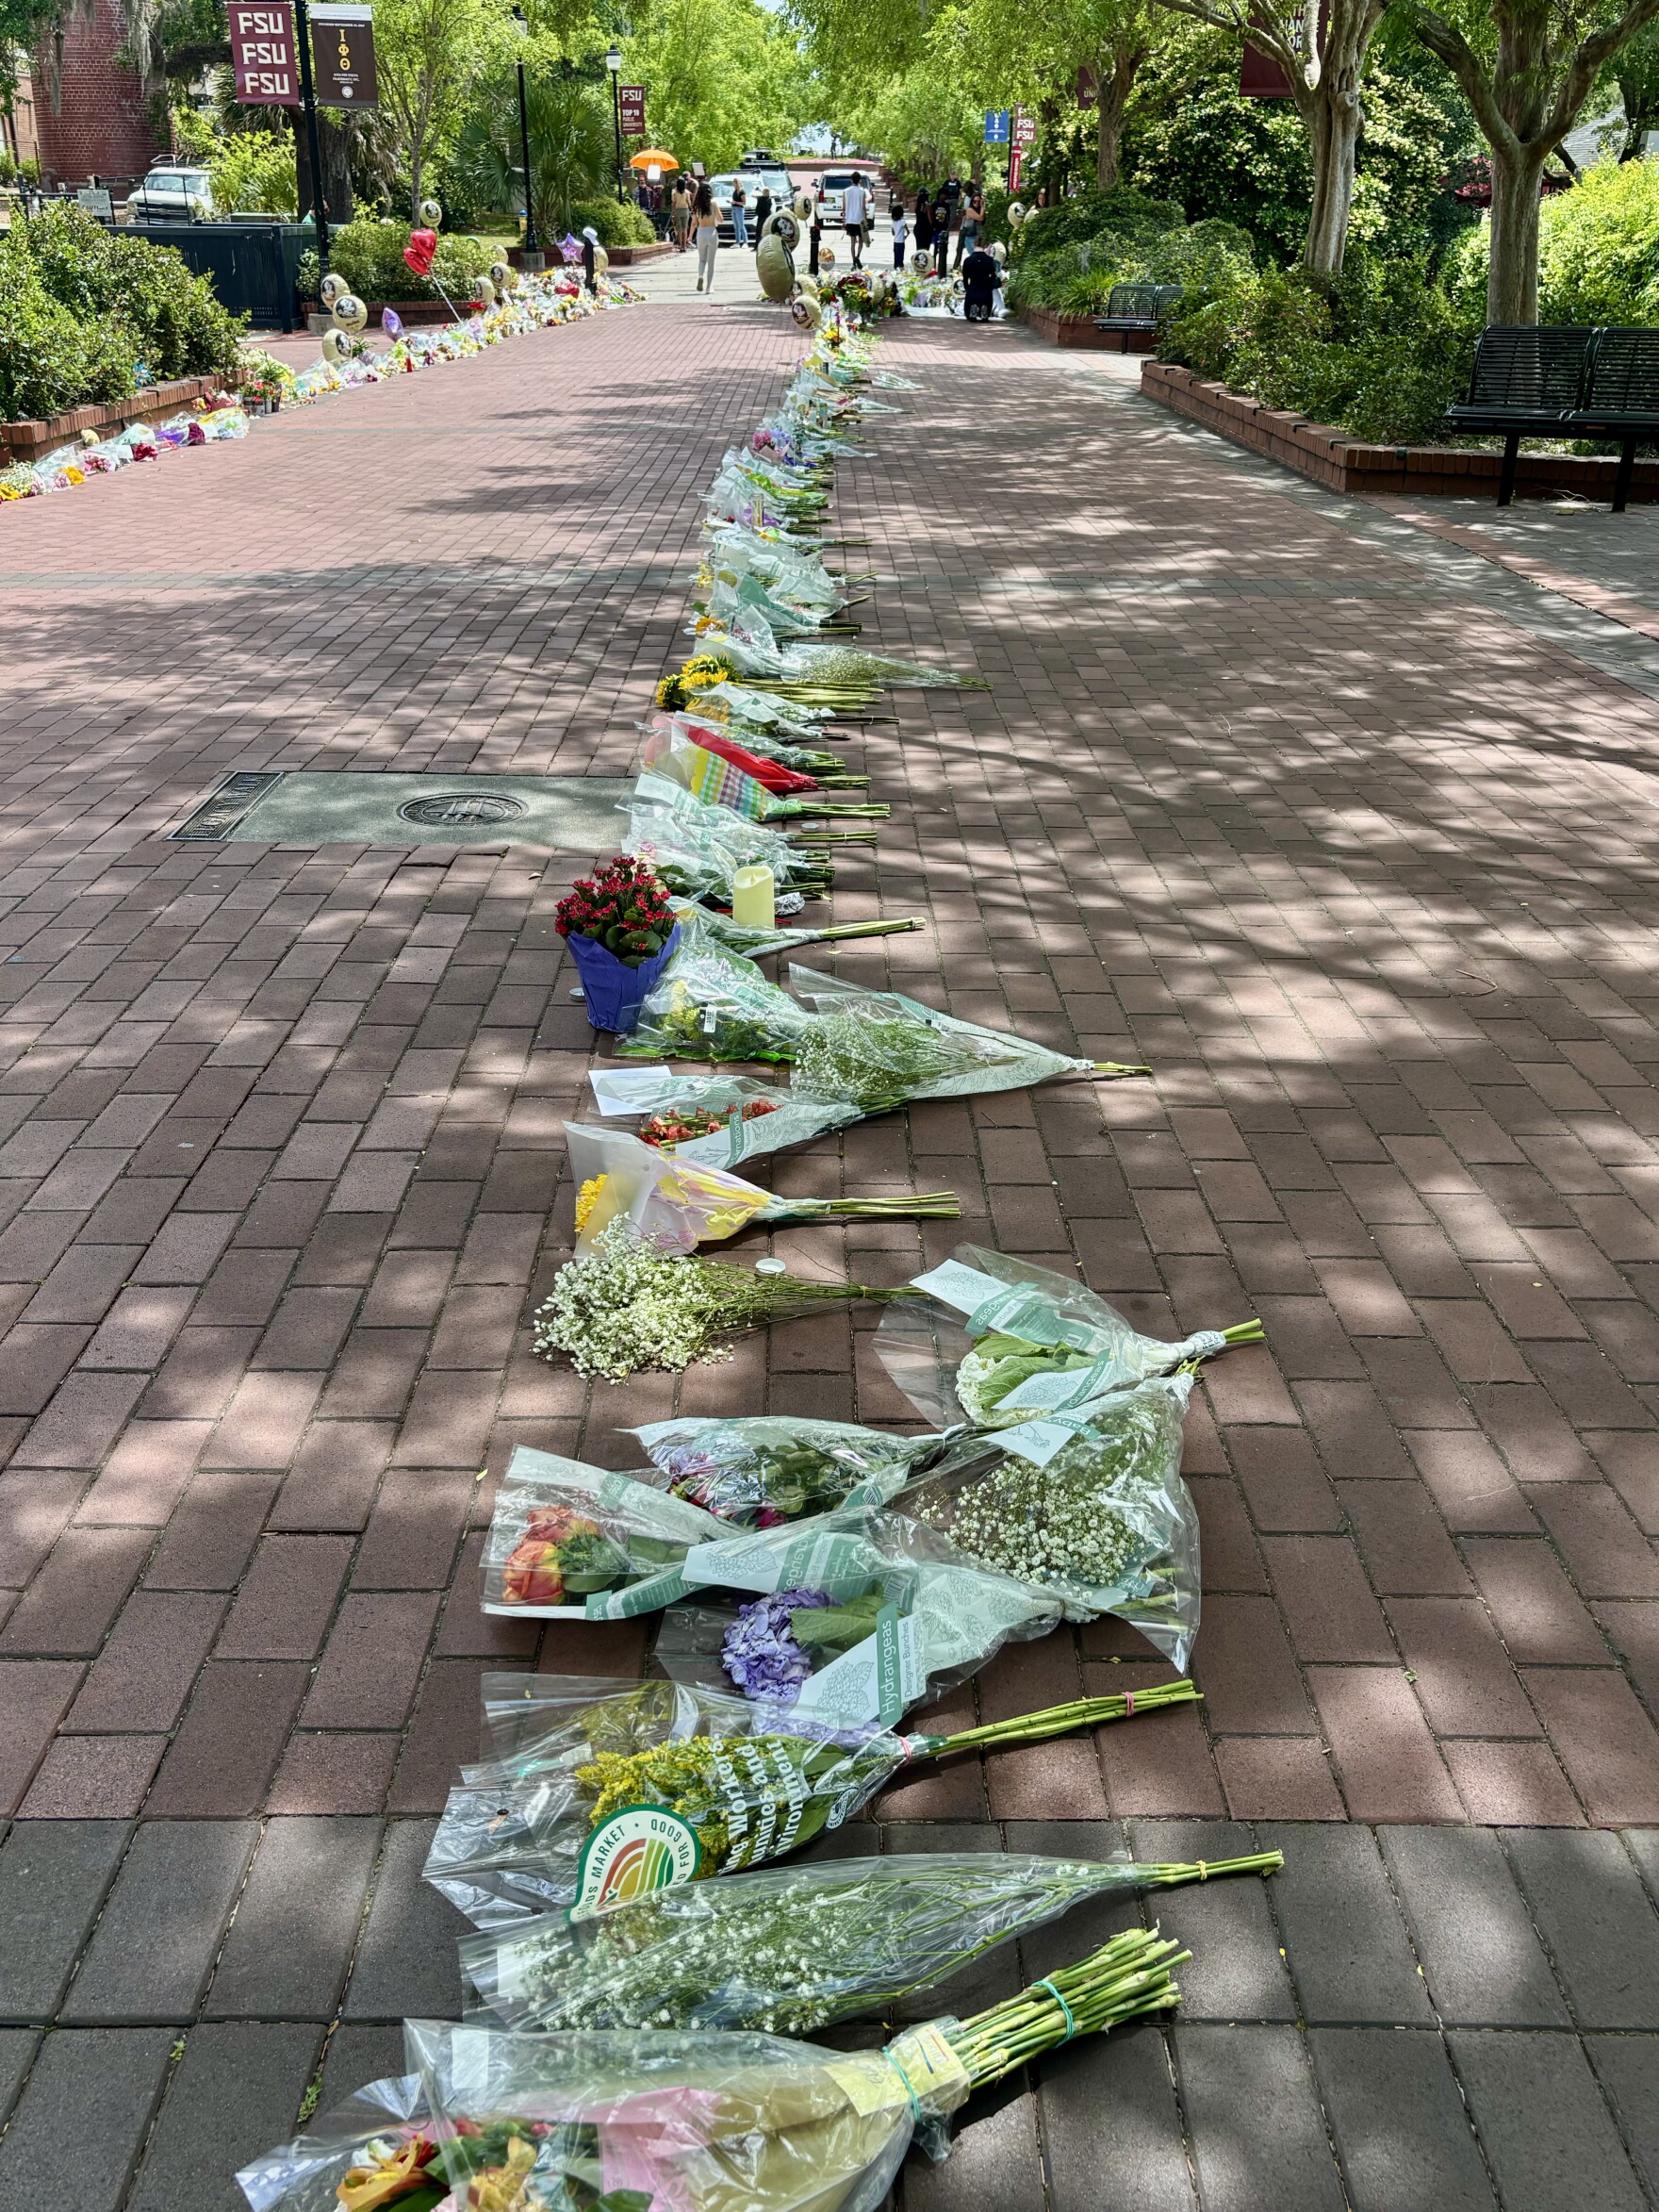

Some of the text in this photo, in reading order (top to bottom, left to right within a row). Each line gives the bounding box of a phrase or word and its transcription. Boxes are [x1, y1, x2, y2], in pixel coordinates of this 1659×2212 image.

[237, 12, 285, 35] FSU
[240, 42, 287, 65] FSU
[244, 73, 290, 94] FSU
[622, 90, 642, 102] FSU
[1016, 130, 1034, 140] FSU
[1017, 119, 1035, 129] FSU
[188, 801, 239, 836] LEGACY
[1059, 1361, 1105, 1411] ydrangeas
[881, 1620, 897, 1716] Hydrangeas
[901, 1622, 914, 1697] Designer Bunches
[734, 1743, 768, 1785] and
[767, 1740, 804, 1856] nvironment
[650, 1819, 682, 1842] GOOD
[591, 1824, 626, 1878] MARKET
[679, 1841, 690, 1868] FOR
